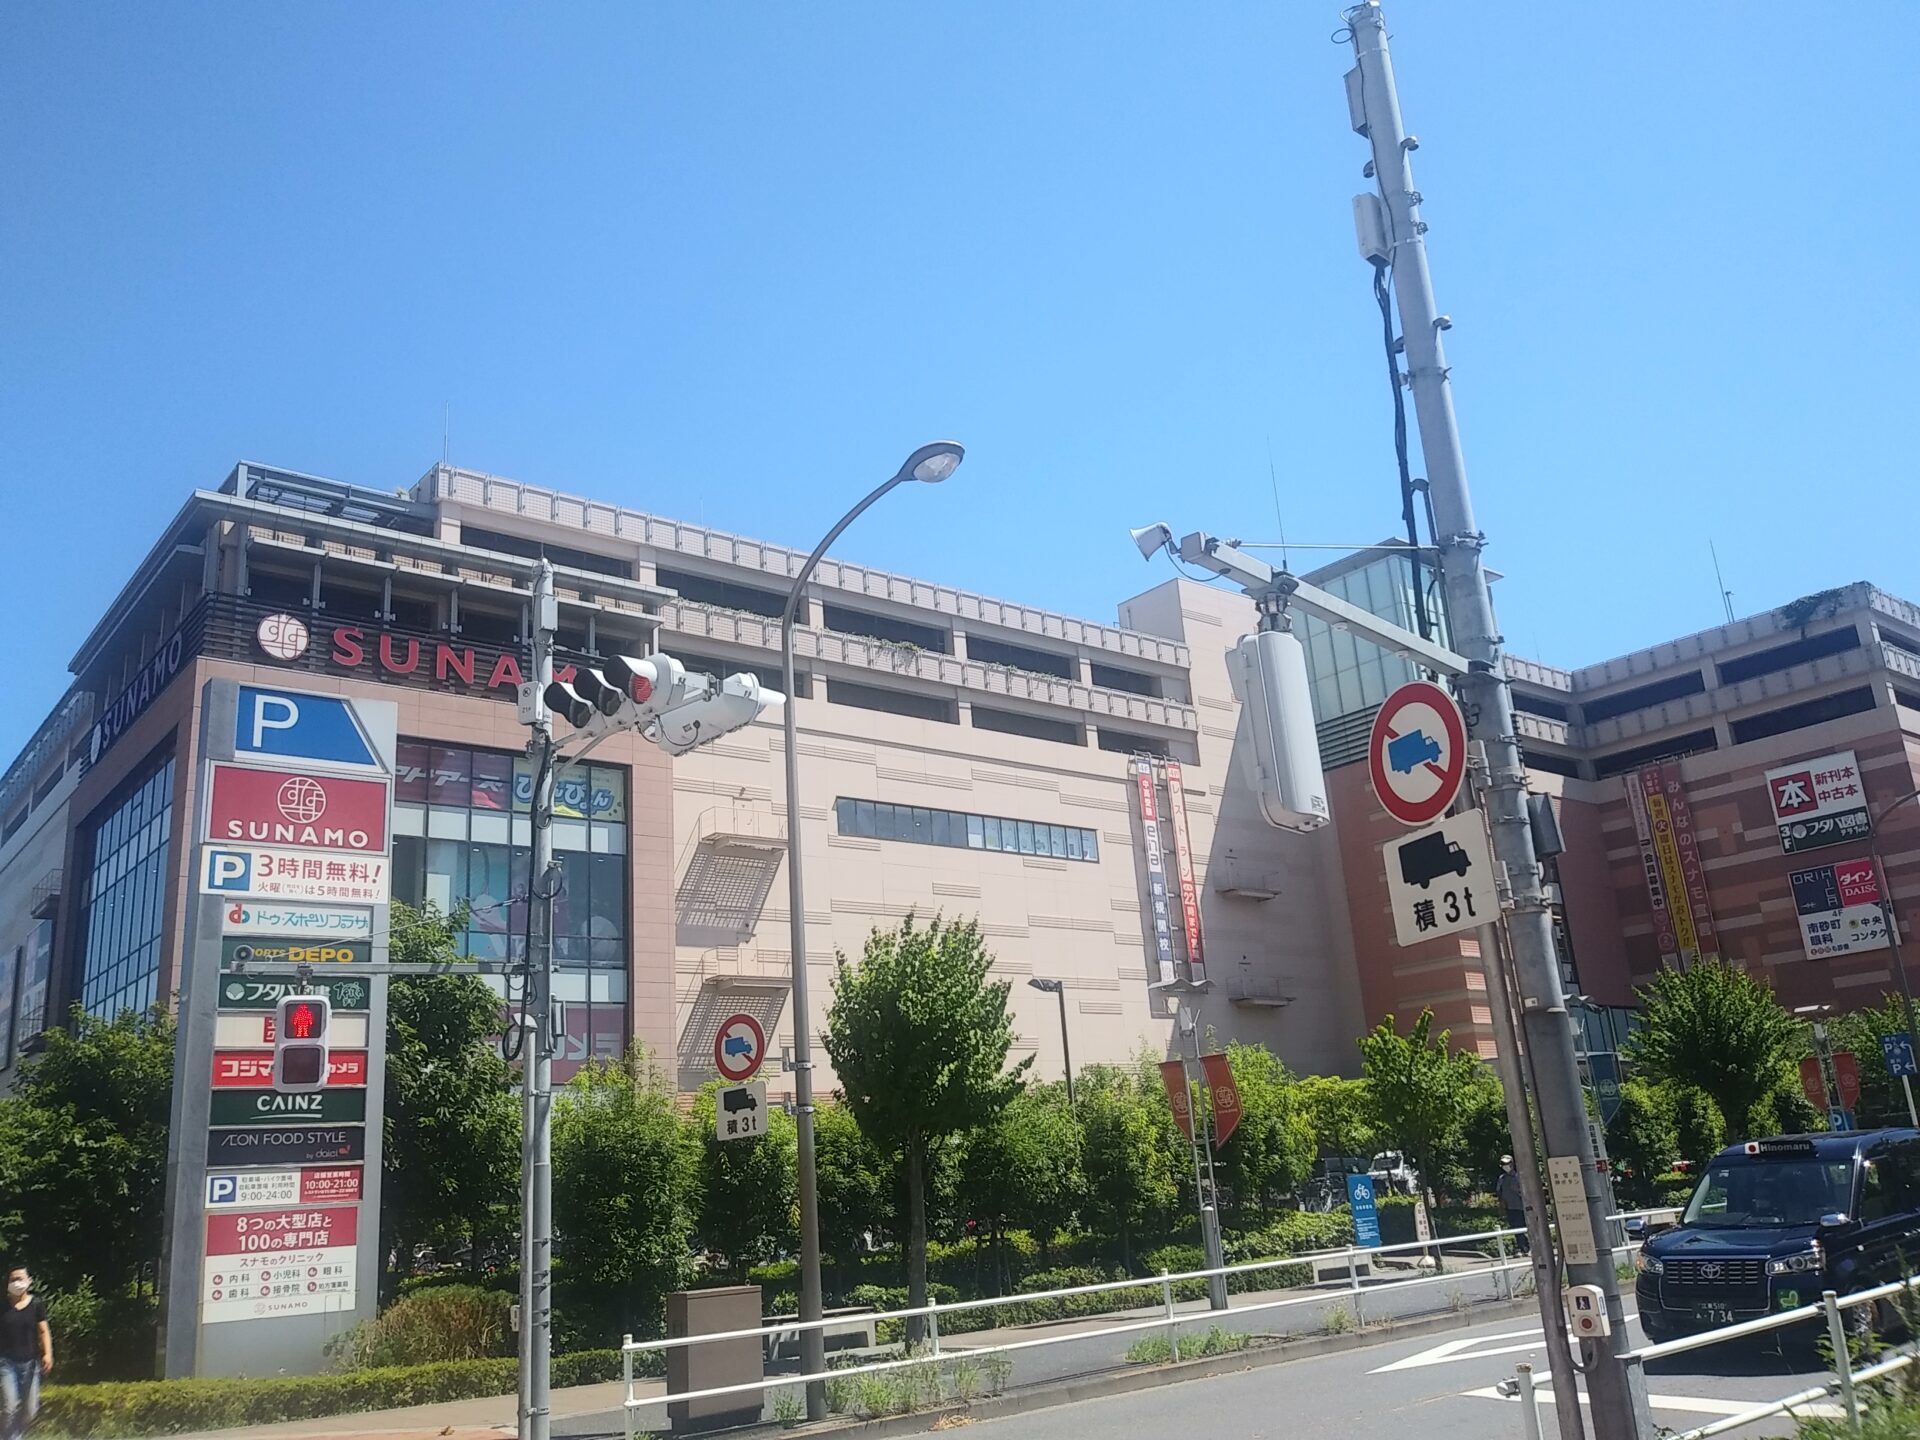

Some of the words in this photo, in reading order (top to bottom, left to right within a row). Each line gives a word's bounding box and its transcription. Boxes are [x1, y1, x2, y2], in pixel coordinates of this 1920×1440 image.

[333, 626, 578, 689] SUNAM
[102, 633, 183, 750] SUNAMO
[252, 693, 299, 748] P
[1814, 766, 1855, 786] 新刊本
[1778, 779, 1812, 809] 本
[1818, 783, 1859, 803] 中古本
[228, 819, 369, 848] SUNAMO
[1172, 781, 1191, 879] レストラン
[1806, 812, 1868, 836] フタバ図書
[213, 854, 246, 887] P
[1840, 869, 1874, 886] ダイソ
[1807, 918, 1841, 934] 南砂町
[1860, 916, 1883, 928] 中央
[1810, 932, 1834, 946] 眼科
[1851, 928, 1887, 943] コンタク
[288, 945, 354, 963] DEPO
[256, 1095, 323, 1111] CAINZ
[263, 1132, 304, 1145] FOOD
[307, 1131, 346, 1144] STYLE
[1760, 1141, 1810, 1152] Hinomaru
[213, 1179, 234, 1201] P
[305, 1179, 359, 1190] 10:00-21:00
[236, 1213, 333, 1233] 8つの大型店と
[239, 1230, 329, 1251] 100の専門店
[240, 1252, 324, 1268] スナモのクリニック
[273, 1269, 301, 1281] 小児科
[268, 1302, 308, 1312] SUNAMO
